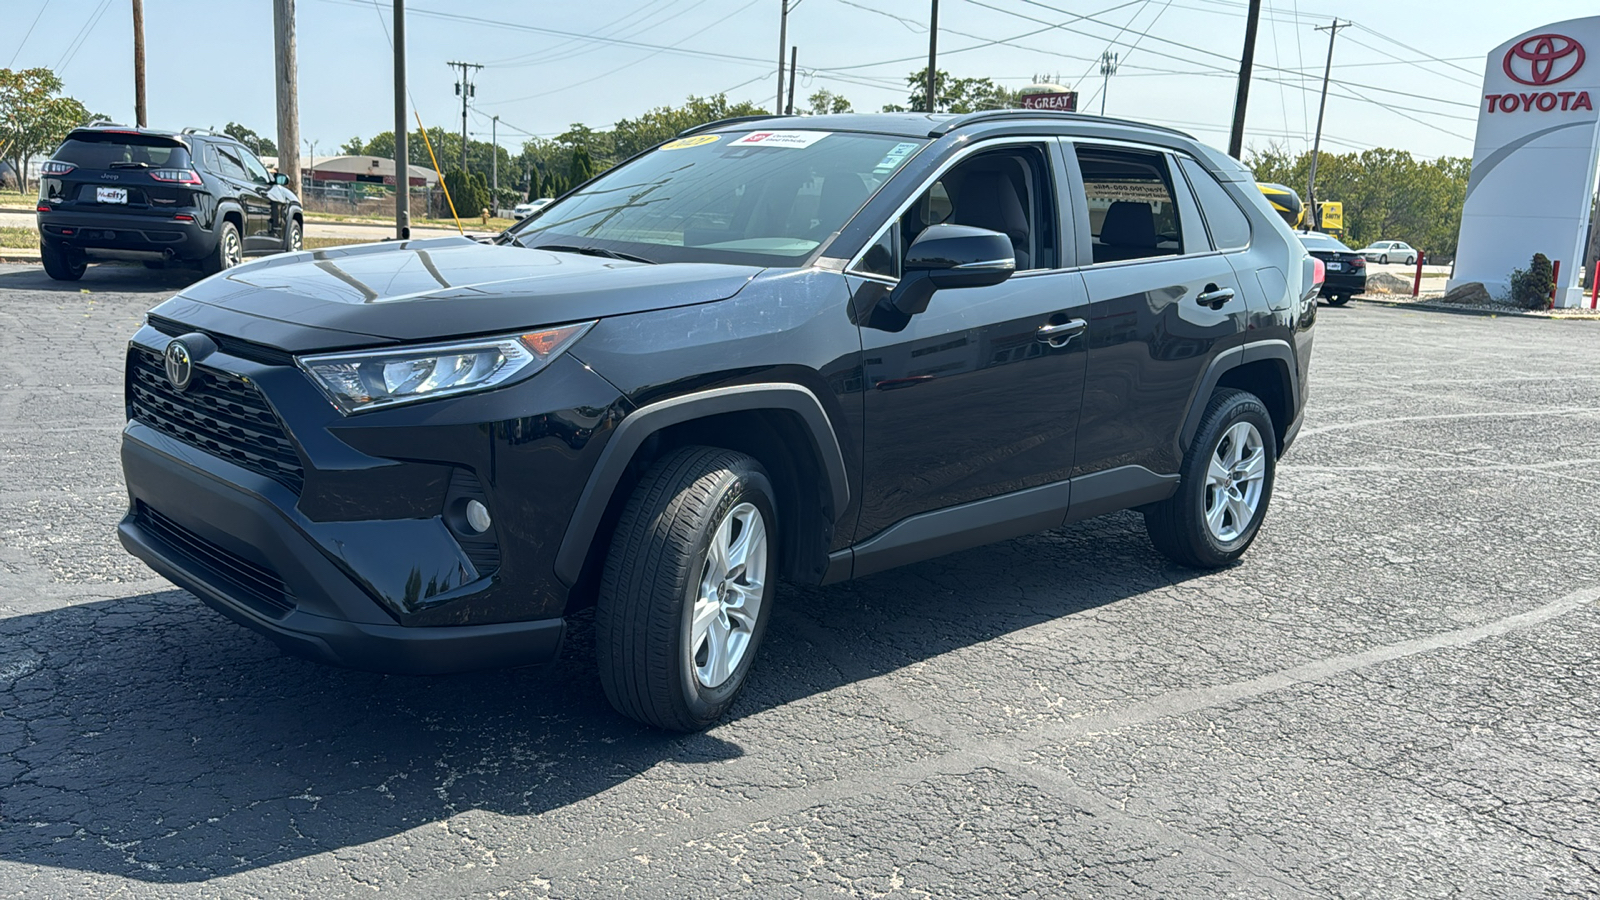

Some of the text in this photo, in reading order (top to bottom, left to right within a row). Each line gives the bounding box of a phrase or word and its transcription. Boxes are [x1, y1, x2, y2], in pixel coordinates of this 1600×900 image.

[1034, 95, 1070, 109] GREAT
[1485, 91, 1593, 113] TOYOTA
[1325, 212, 1341, 220] SMITH
